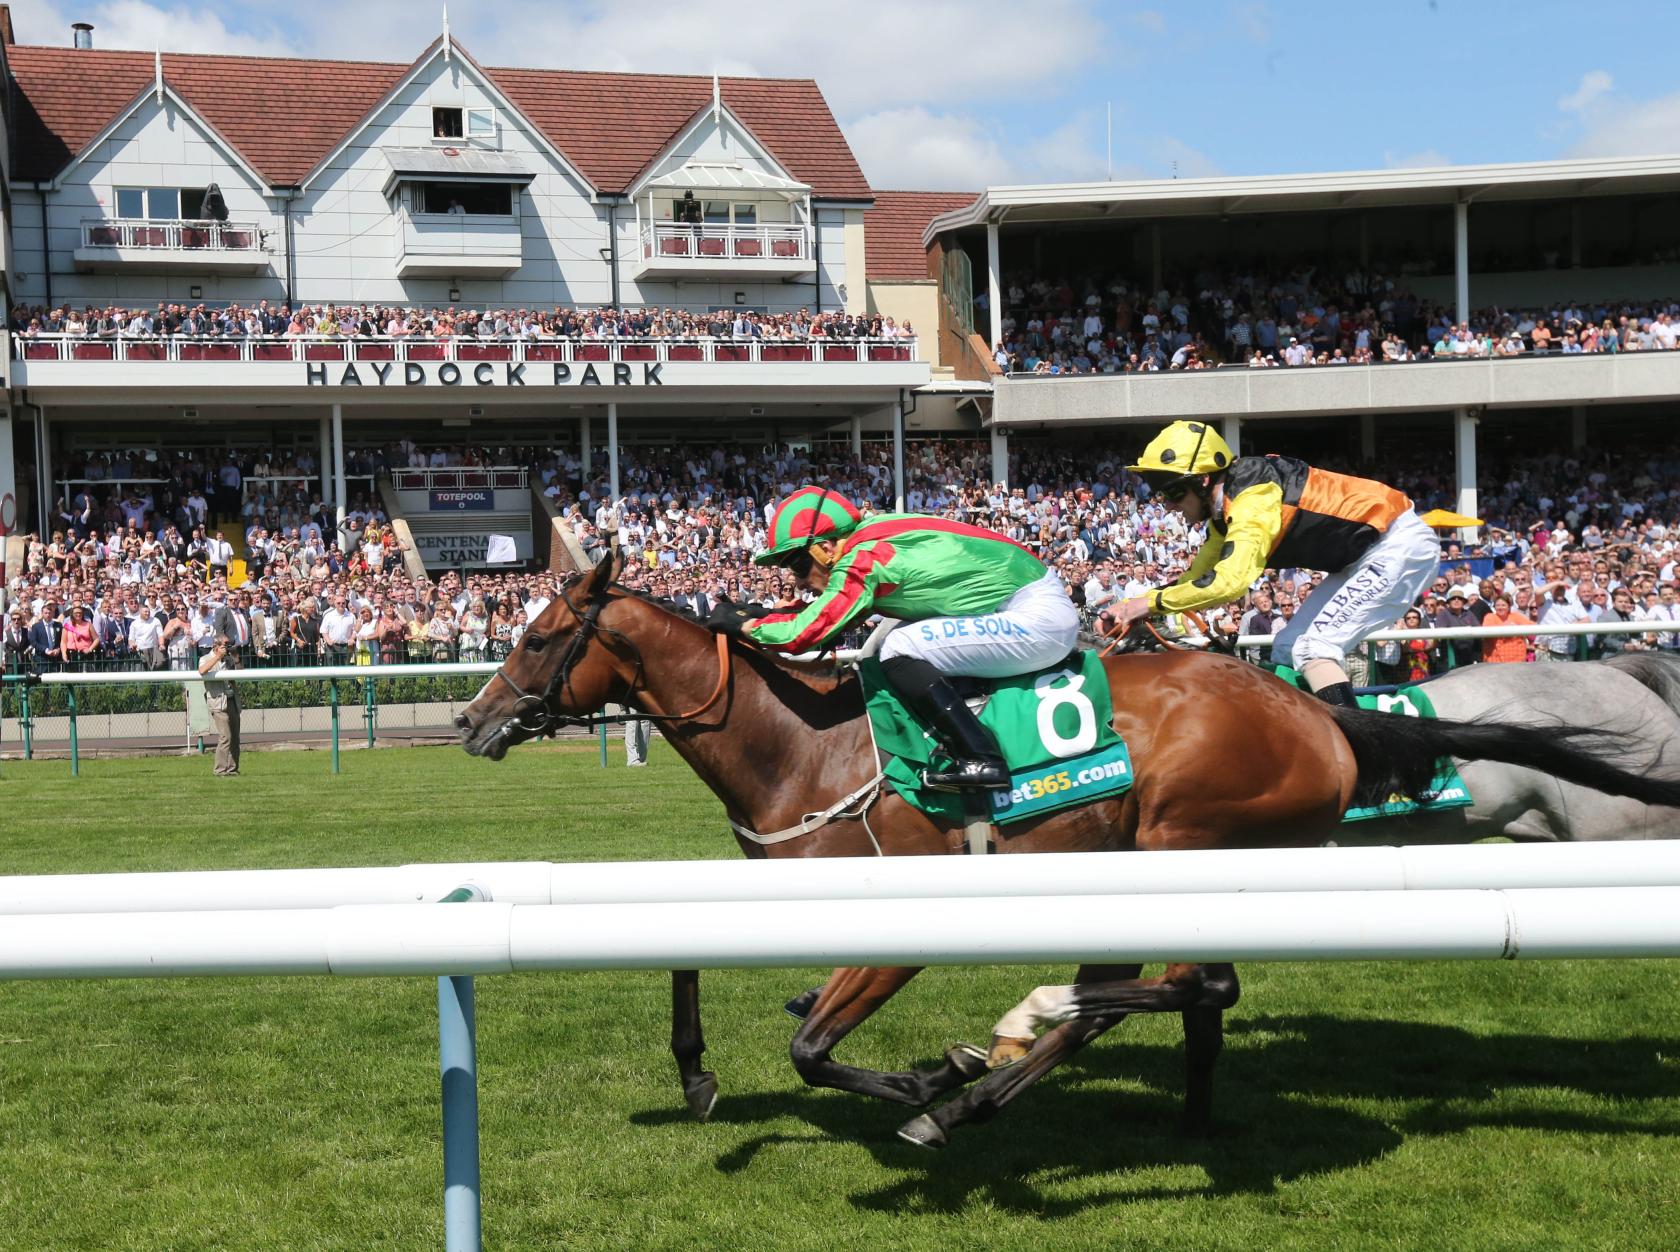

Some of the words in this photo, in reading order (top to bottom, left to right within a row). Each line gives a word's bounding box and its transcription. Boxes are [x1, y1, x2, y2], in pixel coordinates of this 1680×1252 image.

[307, 362, 525, 386] HAYDOCK
[554, 362, 664, 386] PARK
[436, 493, 486, 501] TOTEPOOL
[416, 534, 512, 548] CENTENA
[1331, 577, 1390, 630] EQUIWORLD
[921, 625, 939, 641] S.
[942, 620, 968, 638] DE
[1034, 668, 1098, 758] 8
[992, 759, 1127, 808] bet365.com
